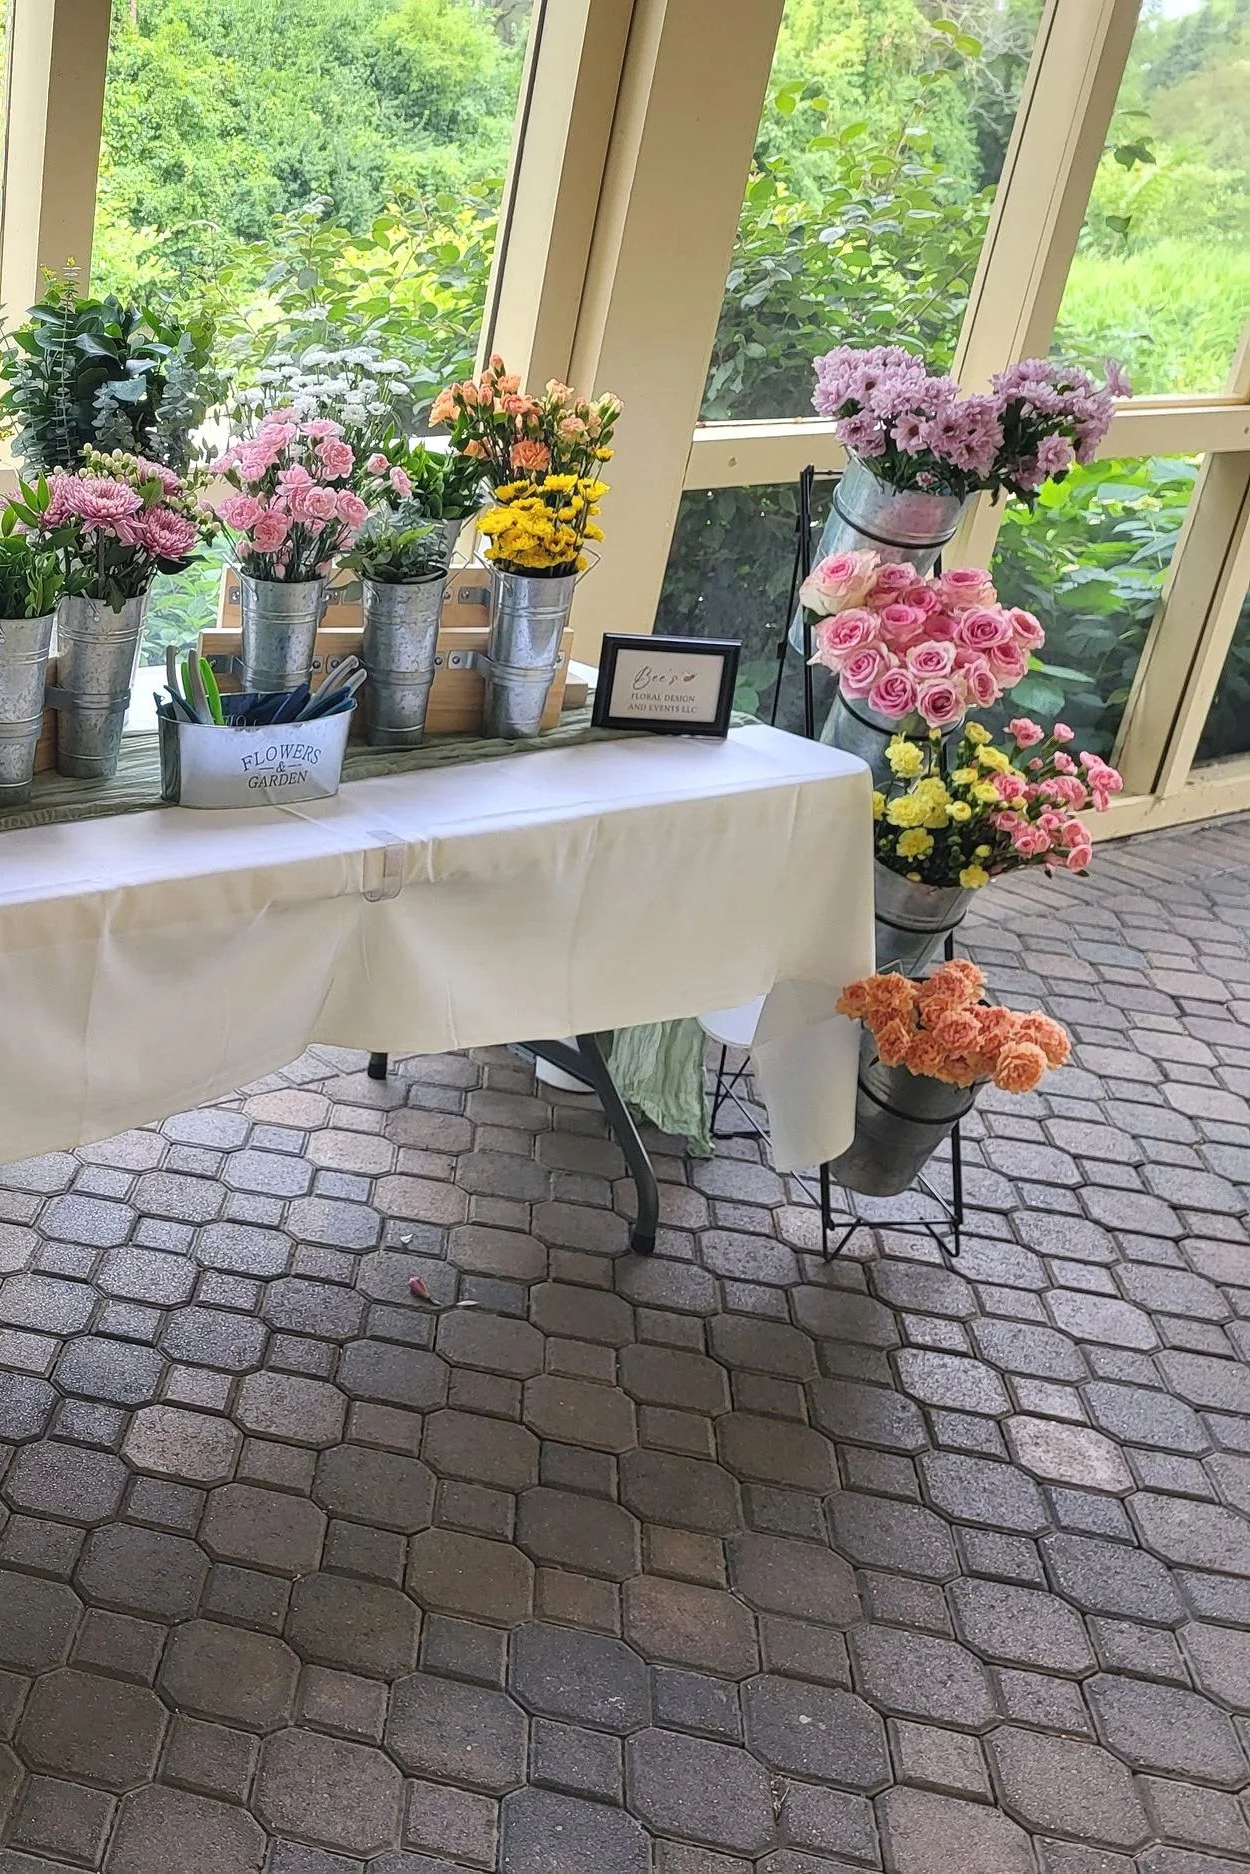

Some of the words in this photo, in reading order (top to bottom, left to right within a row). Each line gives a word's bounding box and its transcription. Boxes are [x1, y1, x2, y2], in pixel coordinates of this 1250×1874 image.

[630, 692, 662, 701] FLORAL
[664, 694, 696, 703] DESIGN
[627, 703, 647, 712] AND
[648, 704, 680, 713] EVENTS
[681, 705, 698, 714] LLC
[241, 743, 322, 772] FLOWERS
[275, 761, 287, 773] &
[248, 770, 309, 789] GARDEN
